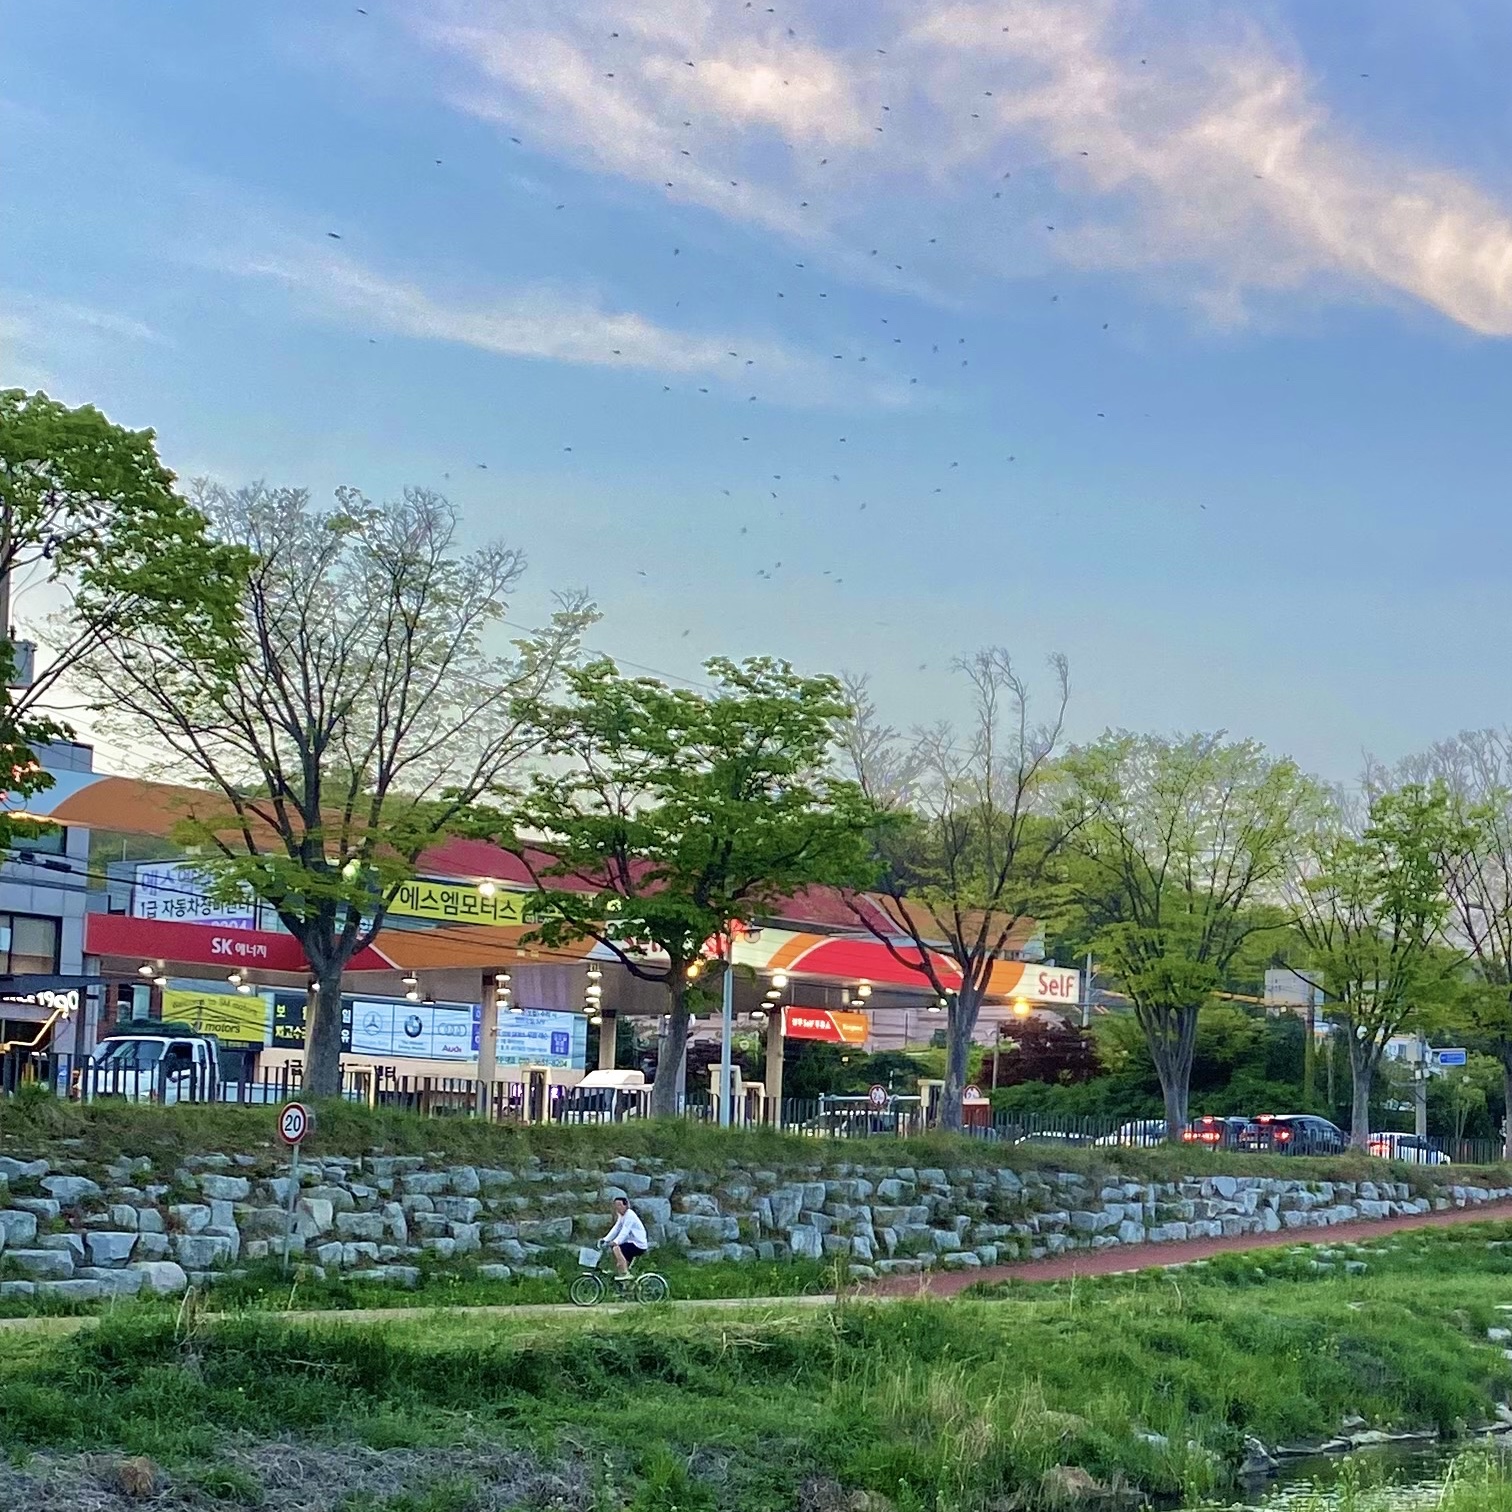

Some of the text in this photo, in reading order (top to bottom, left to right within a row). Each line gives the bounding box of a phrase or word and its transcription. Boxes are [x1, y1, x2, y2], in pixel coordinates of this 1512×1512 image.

[400, 886, 518, 921] 에스엠모터스
[211, 937, 267, 958] SK 에너지
[1038, 971, 1076, 998] Self
[442, 1044, 462, 1053] Audi
[285, 1114, 302, 1132] 20
